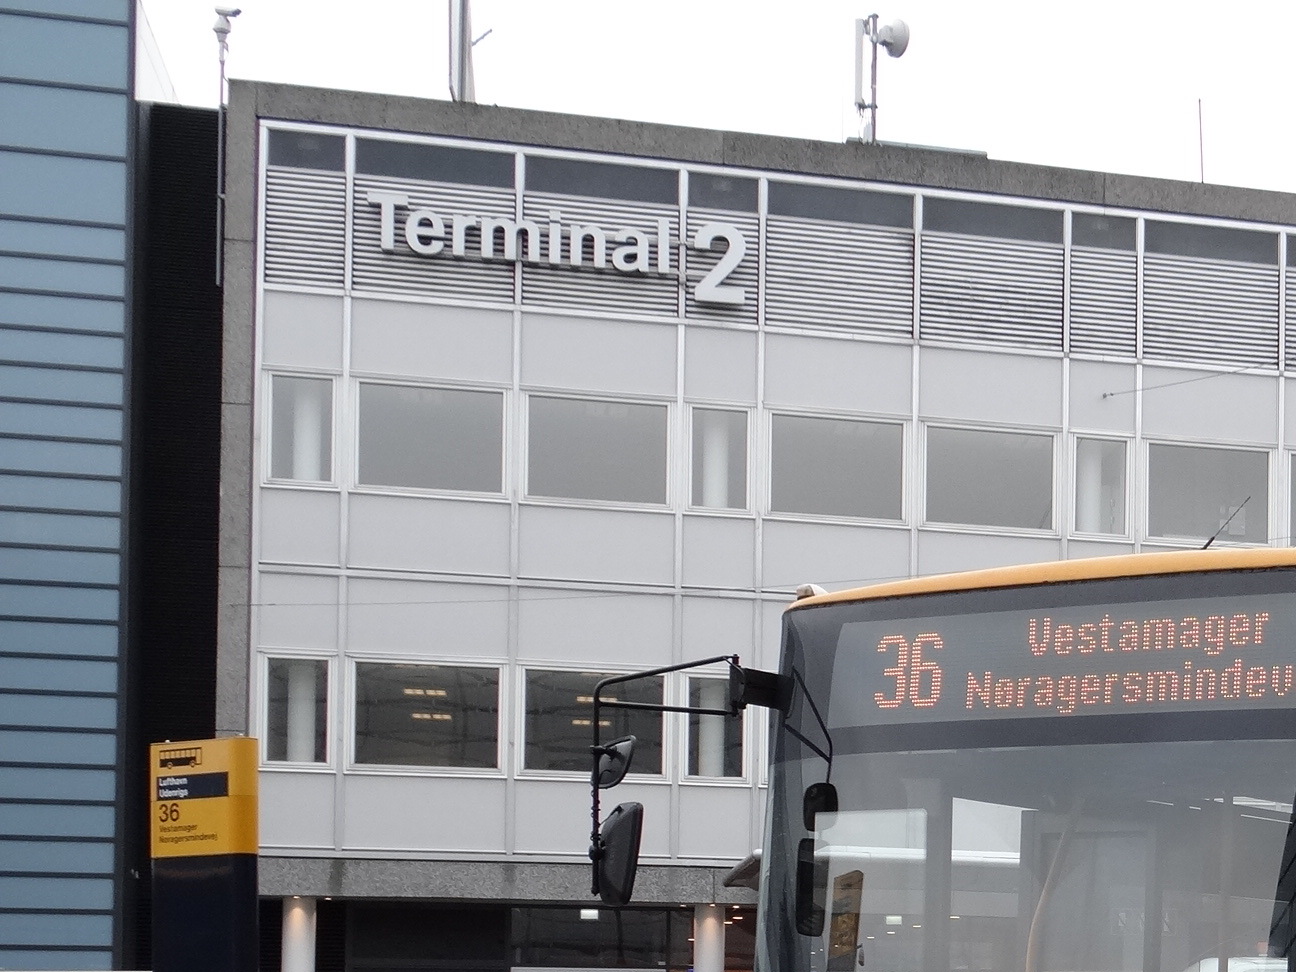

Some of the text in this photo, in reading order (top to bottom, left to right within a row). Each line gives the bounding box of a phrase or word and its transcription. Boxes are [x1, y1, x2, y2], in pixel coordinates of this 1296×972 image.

[366, 191, 748, 305] Terminal 2
[1027, 611, 1270, 657] Vestamager
[872, 631, 945, 710] 36
[159, 777, 188, 786] Lufthavn
[159, 788, 188, 797] Udenrigs
[159, 803, 180, 822] 36
[159, 824, 198, 832] Vestamager
